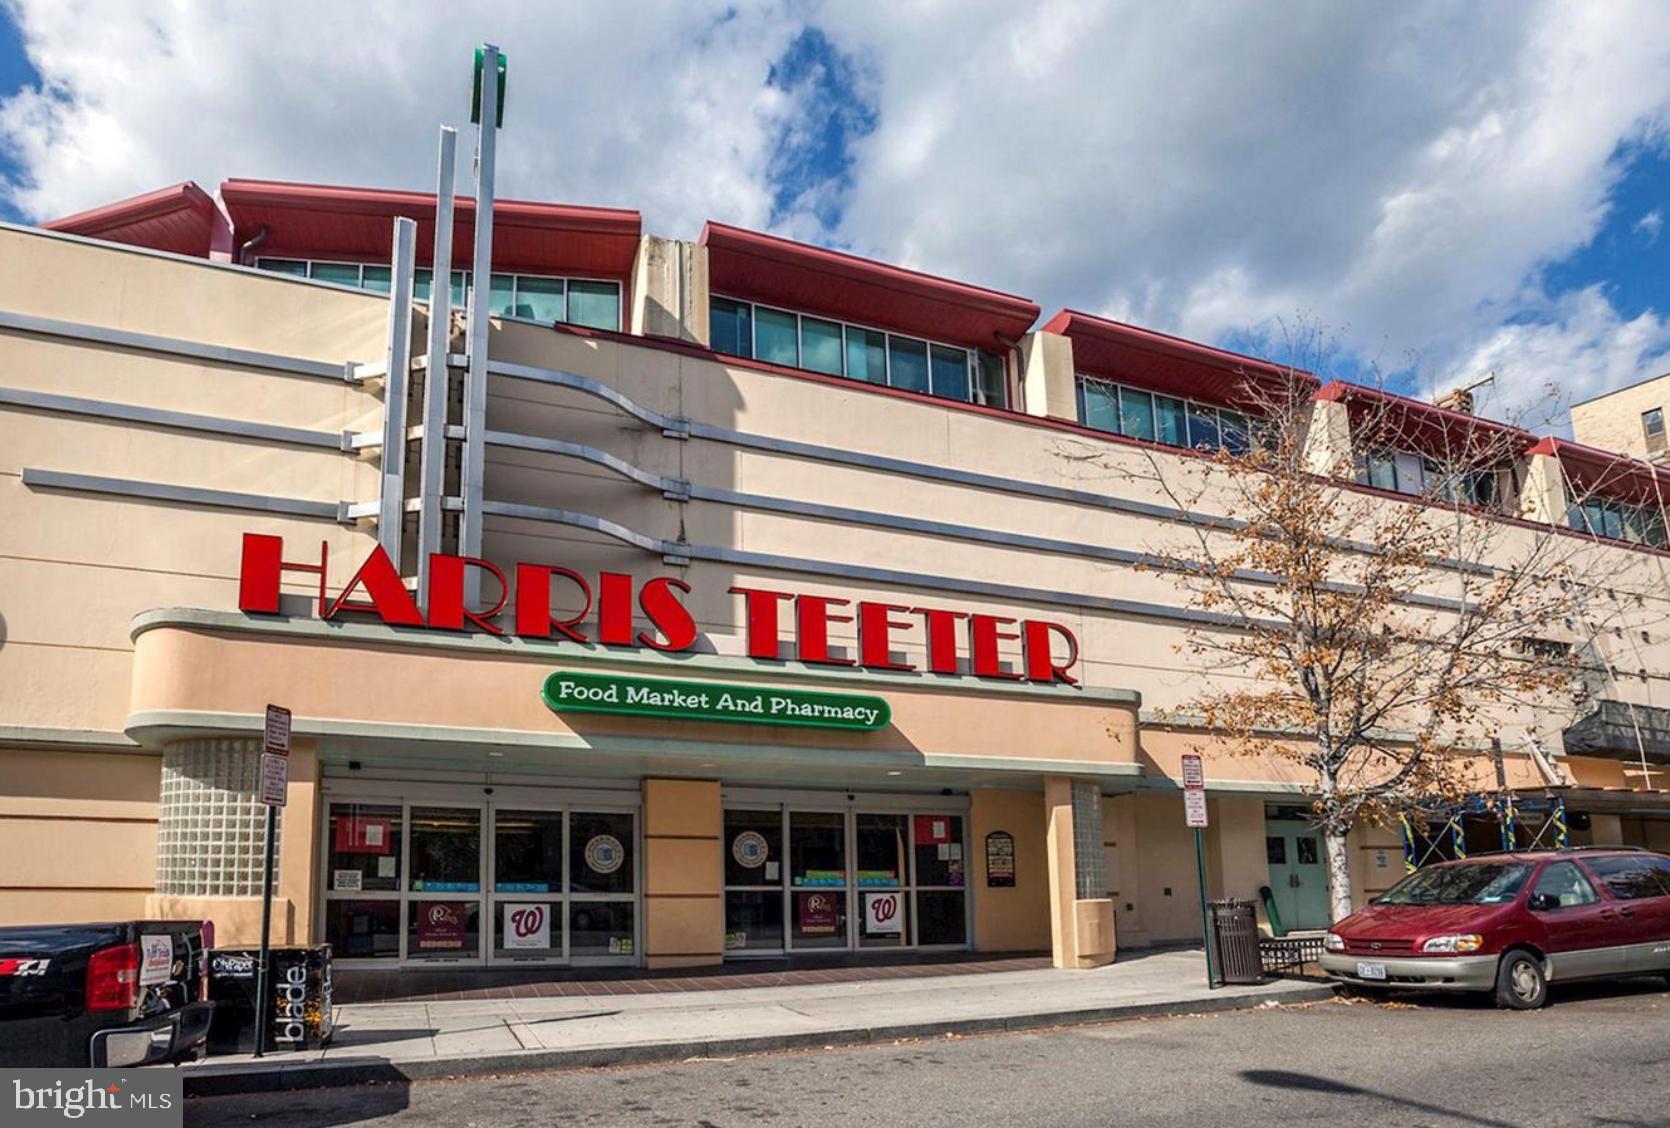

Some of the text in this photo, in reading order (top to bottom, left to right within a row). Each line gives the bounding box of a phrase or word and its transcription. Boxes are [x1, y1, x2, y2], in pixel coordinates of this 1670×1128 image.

[239, 533, 1078, 686] HARRIS TEETER
[559, 681, 879, 725] Food Market And Pharmacy
[511, 906, 543, 937] W
[871, 895, 897, 923] W
[275, 965, 306, 1042] blade
